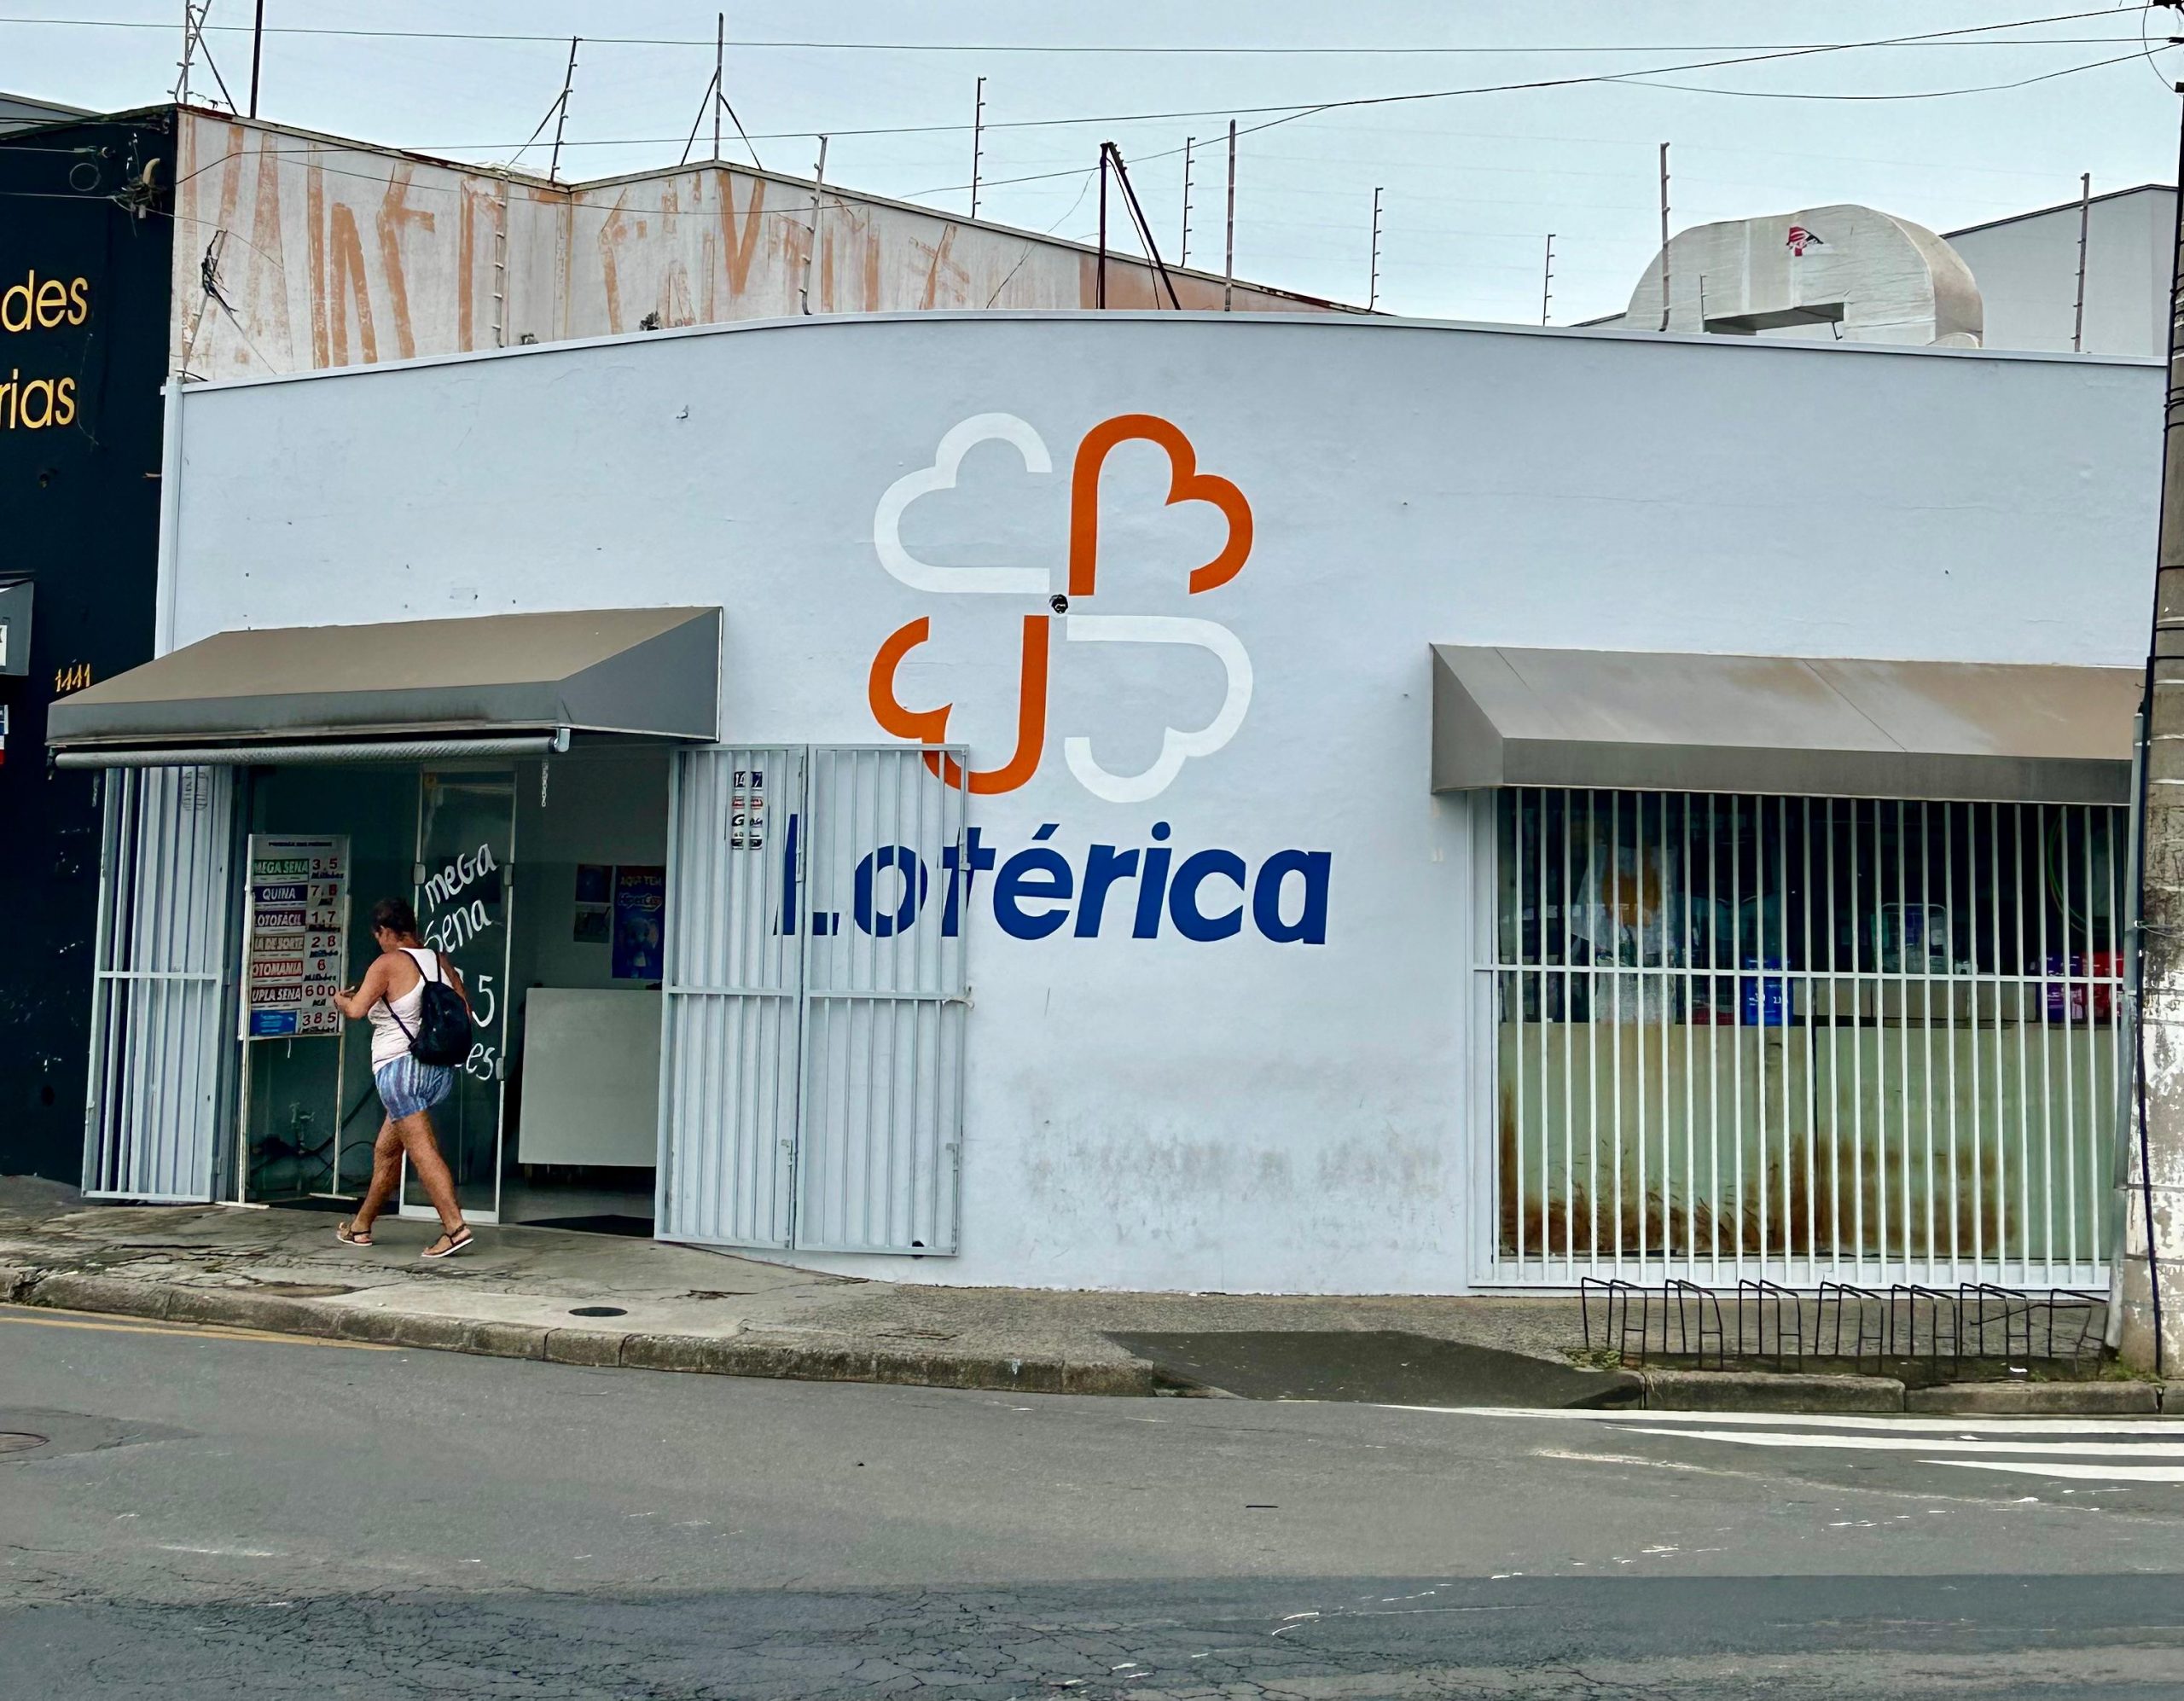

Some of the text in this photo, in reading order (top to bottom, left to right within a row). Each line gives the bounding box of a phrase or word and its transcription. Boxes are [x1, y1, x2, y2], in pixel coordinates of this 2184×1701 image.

[2, 270, 89, 332] des
[283, 860, 308, 874] SENA
[773, 814, 1332, 945] Lotérica
[262, 887, 296, 901] QUINA
[253, 962, 302, 976] OTOMANIA
[253, 987, 301, 1001] UPLA SENA
[305, 984, 336, 997] 600
